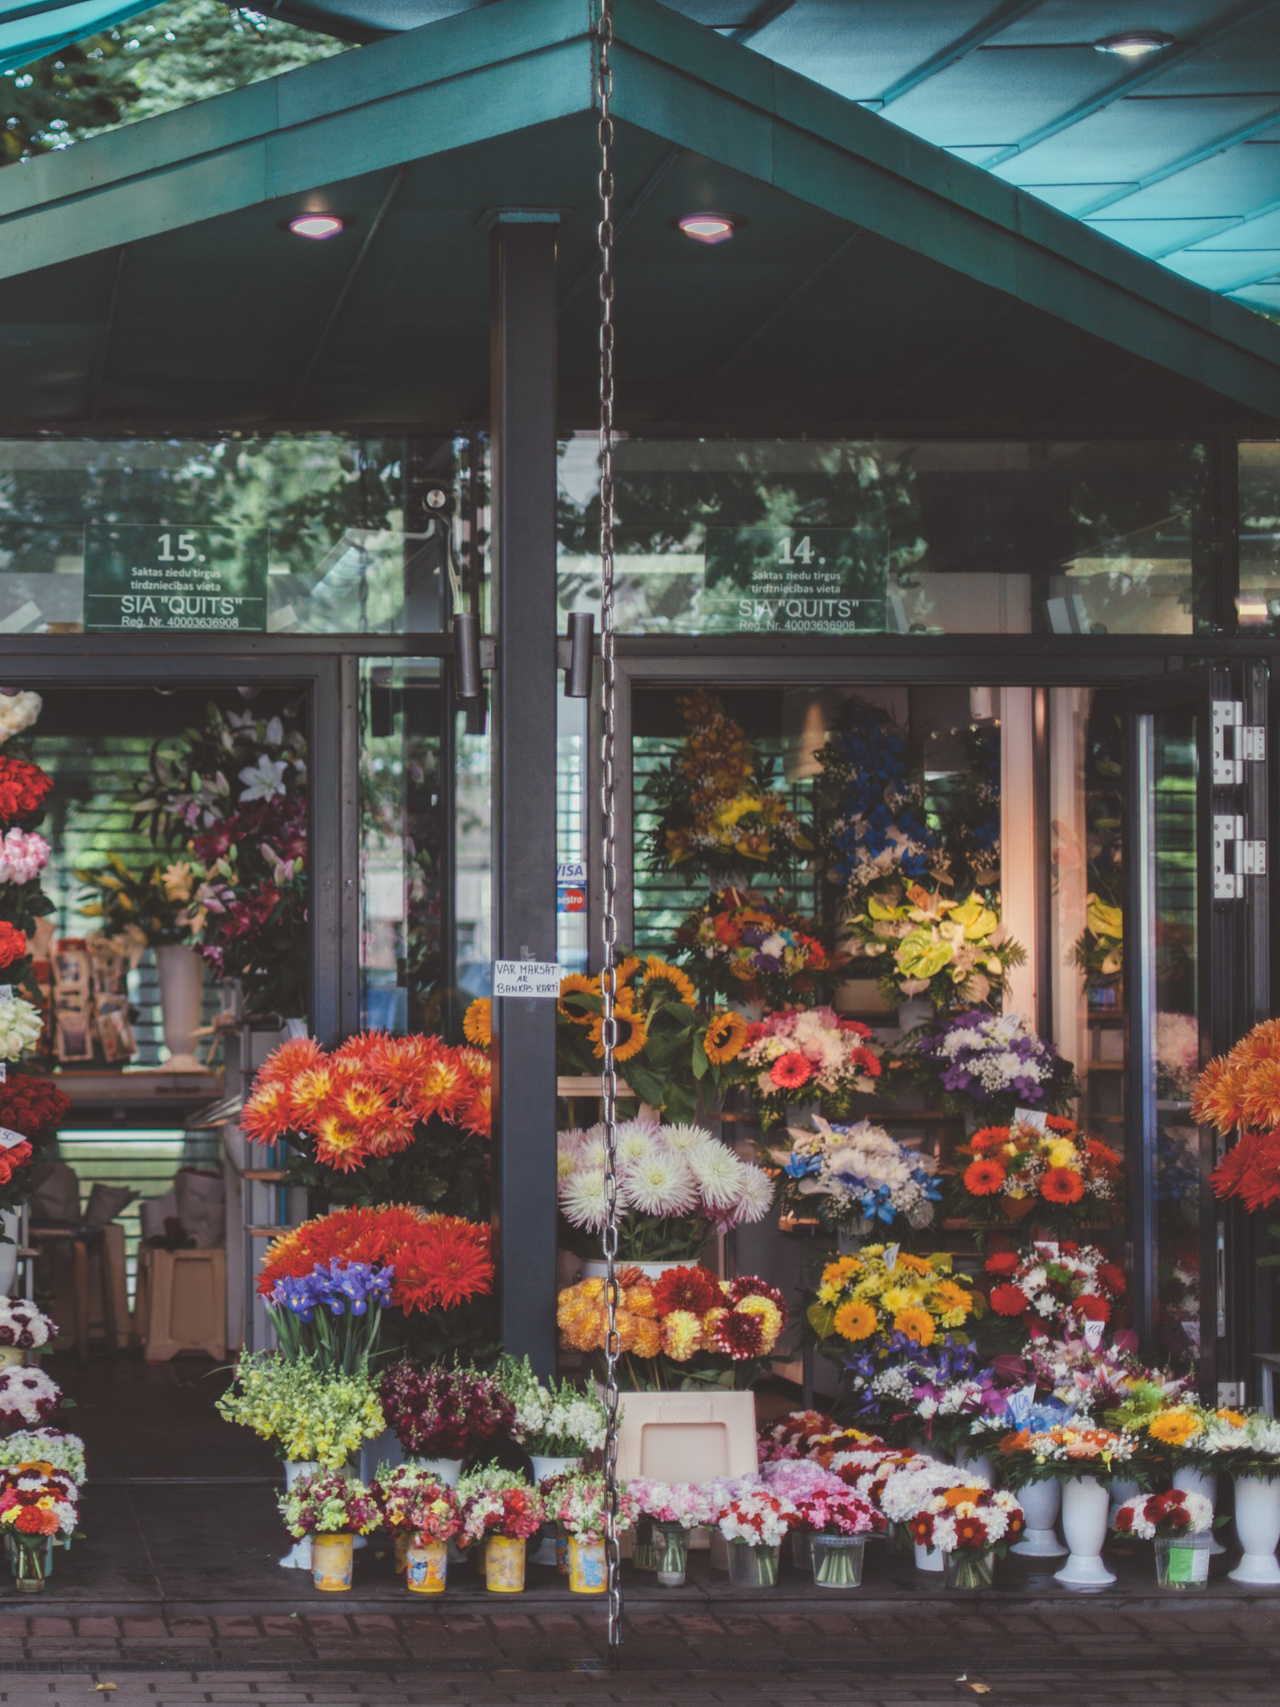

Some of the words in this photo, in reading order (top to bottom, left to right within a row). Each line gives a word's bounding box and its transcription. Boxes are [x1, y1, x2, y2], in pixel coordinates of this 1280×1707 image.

[157, 533, 206, 562] 15.
[778, 536, 826, 565] 14.
[131, 567, 163, 577] Saktas
[165, 567, 191, 578] ziedu
[193, 568, 221, 580] tirgus
[752, 571, 783, 580] Saktas
[785, 571, 811, 580] ziedu
[814, 571, 841, 582] tirgus
[131, 580, 194, 591] tirdzniecības
[196, 582, 221, 592] vieta
[816, 585, 840, 594] vieta
[120, 596, 156, 614] SIA
[161, 597, 243, 615] "QUITS"
[738, 600, 773, 618] SIA
[778, 600, 859, 618] "QUITS"
[149, 617, 164, 627] Nr.
[167, 617, 239, 628] 40003636908
[766, 620, 782, 630] Nr.
[784, 620, 856, 631] 40003636908
[496, 964, 516, 975] VAR
[517, 975, 528, 983] AR
[496, 983, 534, 994] BANKAS
